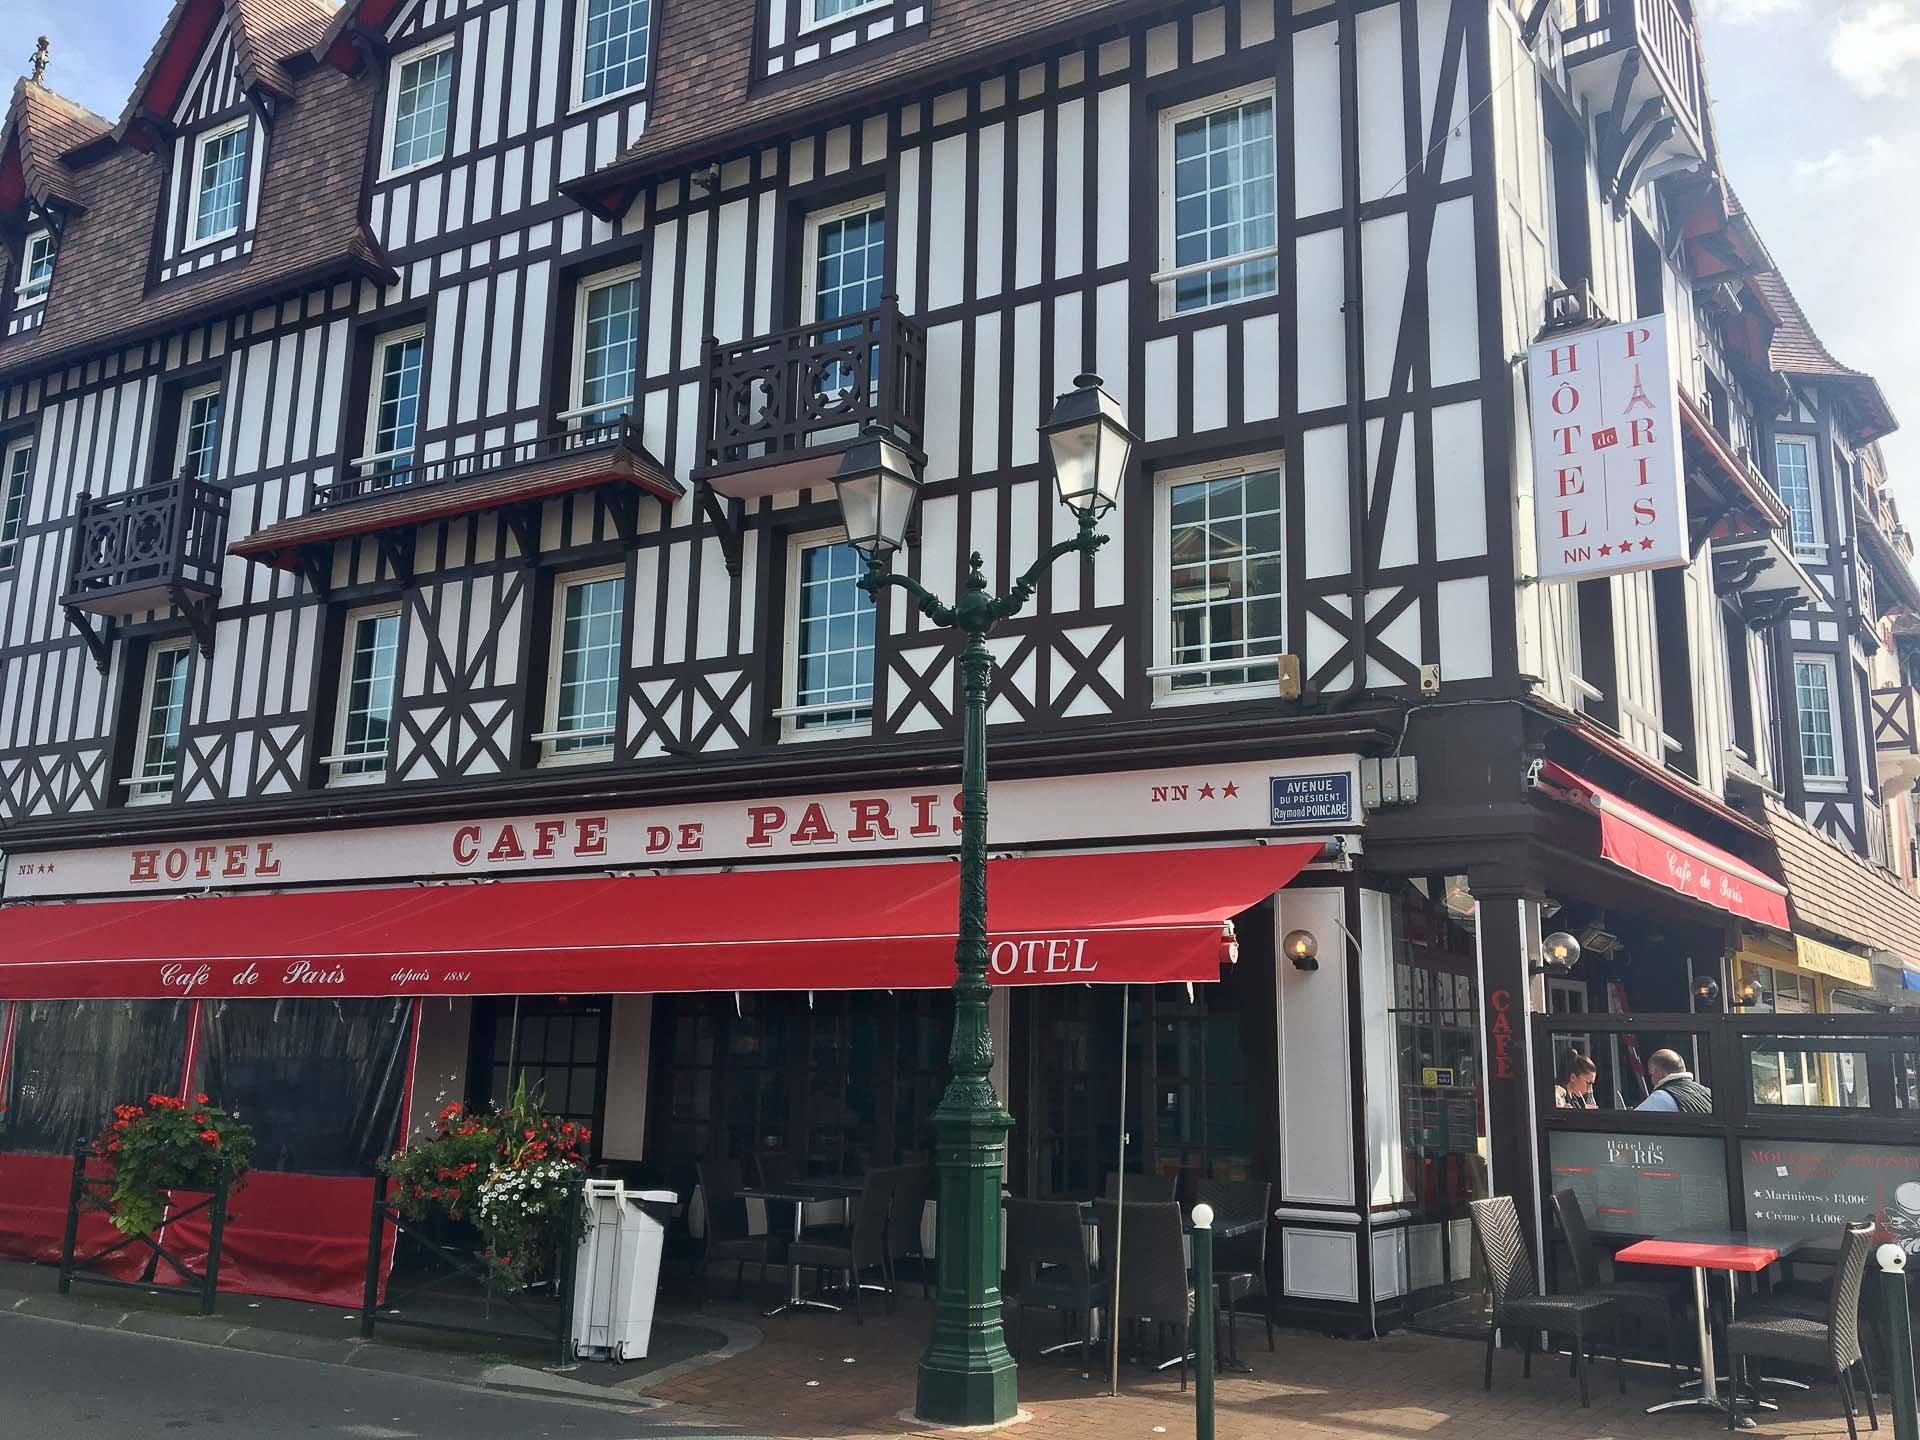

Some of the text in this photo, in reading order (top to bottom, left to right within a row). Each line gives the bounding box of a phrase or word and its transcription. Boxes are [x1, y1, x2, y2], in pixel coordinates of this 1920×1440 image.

[1546, 343, 1587, 540] HÔTEL
[1597, 432, 1615, 446] de
[1564, 546, 1591, 564] NN
[1151, 785, 1190, 802] NN
[1287, 780, 1333, 793] AVENUE
[1280, 793, 1340, 805] DU PRÉSIDENT
[1274, 801, 1347, 820] Raymond POINCARÉ
[453, 816, 608, 867] CAFE
[645, 822, 704, 855] DE
[18, 863, 35, 876] NN
[130, 842, 282, 883] HOTEL
[1699, 866, 1712, 890] de
[1720, 874, 1744, 904] Paris
[984, 939, 1098, 976] OTEL
[160, 959, 346, 995] Café de Paris
[390, 967, 472, 986] depuis 1881
[1607, 1140, 1663, 1151] Hôtel de
